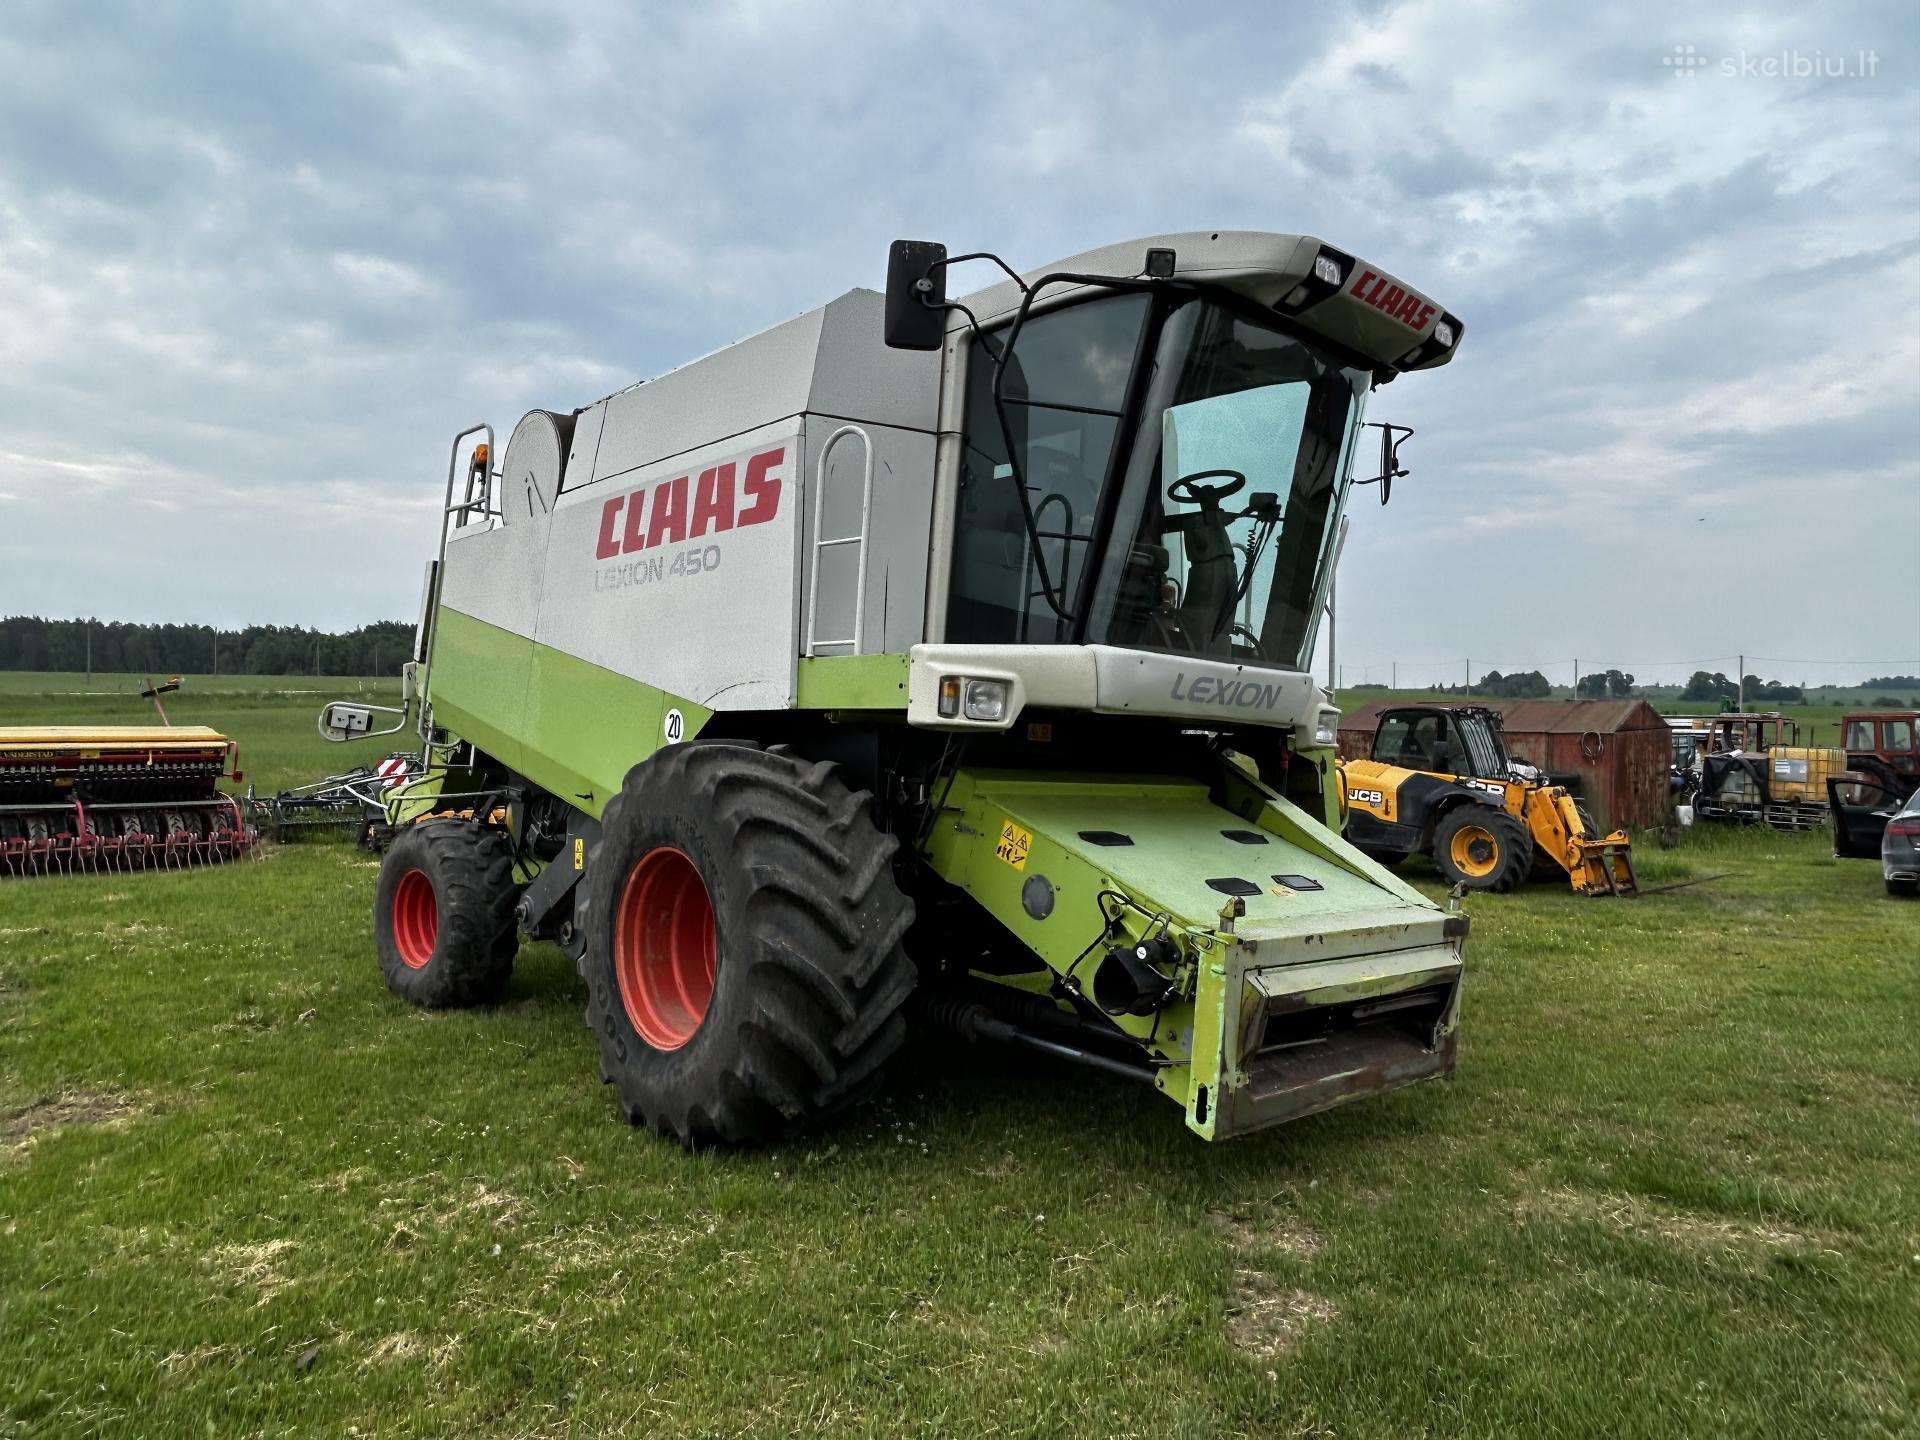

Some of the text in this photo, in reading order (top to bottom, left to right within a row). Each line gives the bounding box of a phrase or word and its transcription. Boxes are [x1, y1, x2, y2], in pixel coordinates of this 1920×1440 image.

[1350, 270, 1436, 331] CLAAS
[596, 447, 785, 560] CLAAS
[669, 545, 721, 577] 450
[1170, 672, 1283, 710] LEXION
[668, 714, 680, 739] 20
[1349, 789, 1382, 803] JCB
